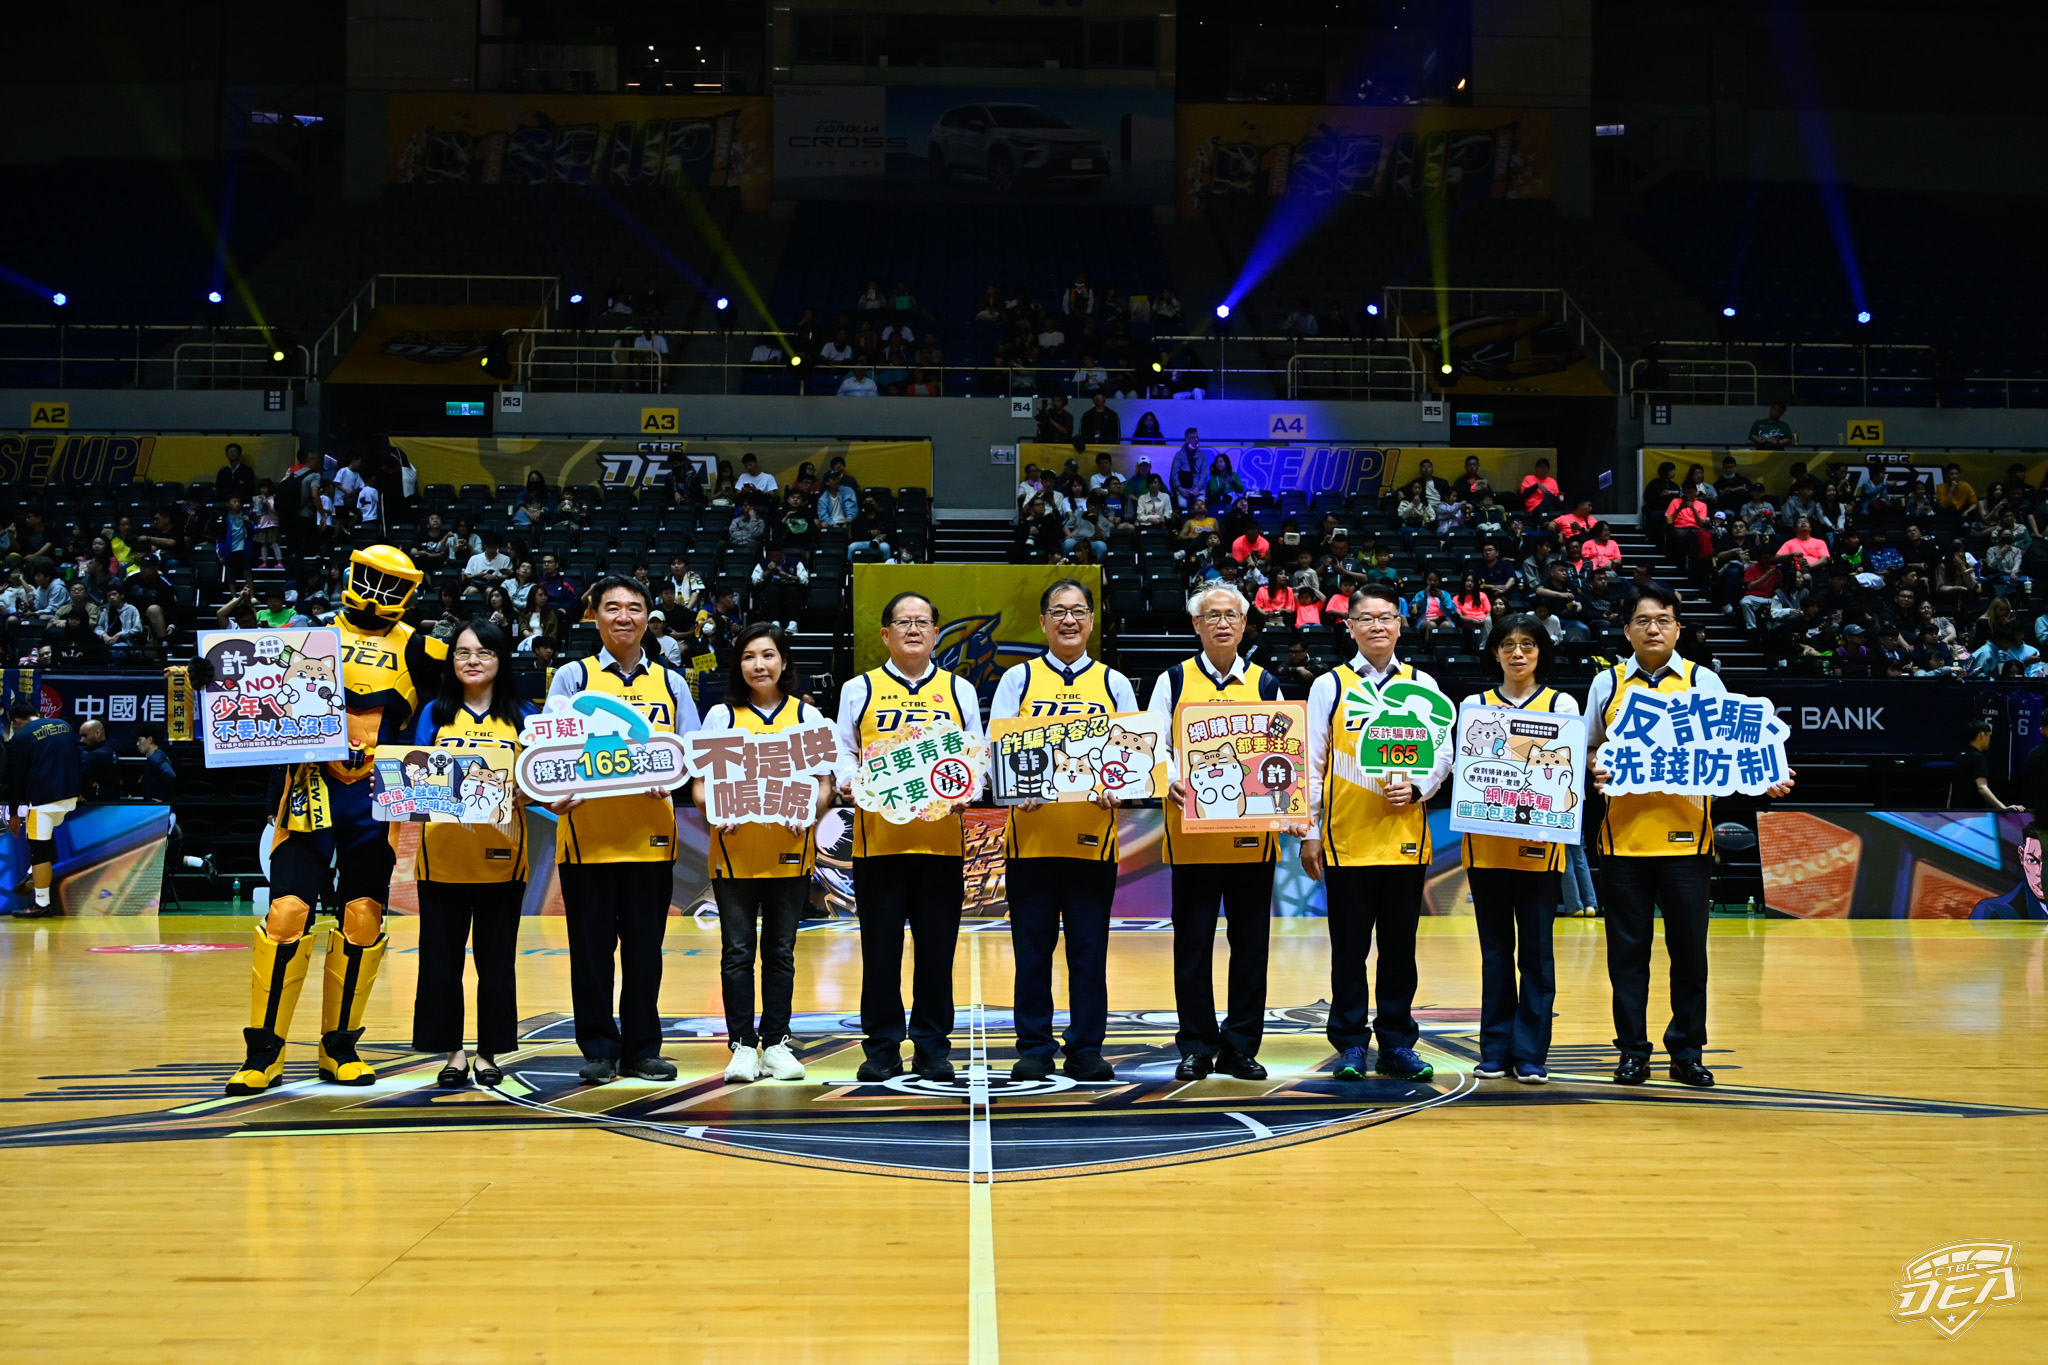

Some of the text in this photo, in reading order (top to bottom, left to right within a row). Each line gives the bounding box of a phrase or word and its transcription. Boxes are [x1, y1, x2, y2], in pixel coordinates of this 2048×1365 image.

[815, 125, 879, 134] COROLLA
[788, 136, 909, 148] CROSS
[502, 397, 521, 407] 西3
[1012, 402, 1031, 413] 西4
[1424, 405, 1442, 417] 西5
[34, 408, 66, 423] A2
[643, 414, 676, 430] A3
[1272, 418, 1304, 433] A4
[1850, 426, 1880, 441] A5
[637, 443, 683, 452] CTBC
[60, 436, 156, 487] UP!
[1866, 454, 1910, 464] CTBC
[1310, 448, 1398, 498] UP!
[221, 650, 247, 675] 詐
[342, 645, 398, 671] DEA
[245, 674, 283, 693] NO!
[214, 715, 340, 741] 不要以為沒事
[1188, 714, 1271, 743] 網購買賣
[1801, 707, 1885, 730] BANK
[2018, 719, 2028, 735] 6
[1001, 715, 1109, 755] 詐騙零容忍
[1369, 727, 1427, 740] 反詐騙專線
[692, 727, 838, 780] 不提供
[868, 731, 965, 781] 只要青春
[1236, 737, 1301, 755] 都要注意
[1378, 744, 1418, 765] 165
[535, 749, 673, 782] 撥打165求證
[1018, 751, 1040, 771] 詐
[1603, 744, 1780, 786] 洗錢防制
[309, 766, 321, 802] NEW
[1267, 765, 1286, 784] 詐
[378, 786, 451, 806] 拒借金融帳戶
[713, 779, 812, 820] 帳號
[1485, 787, 1552, 811] 網購詐騙
[391, 800, 466, 817] 拒提不明款項
